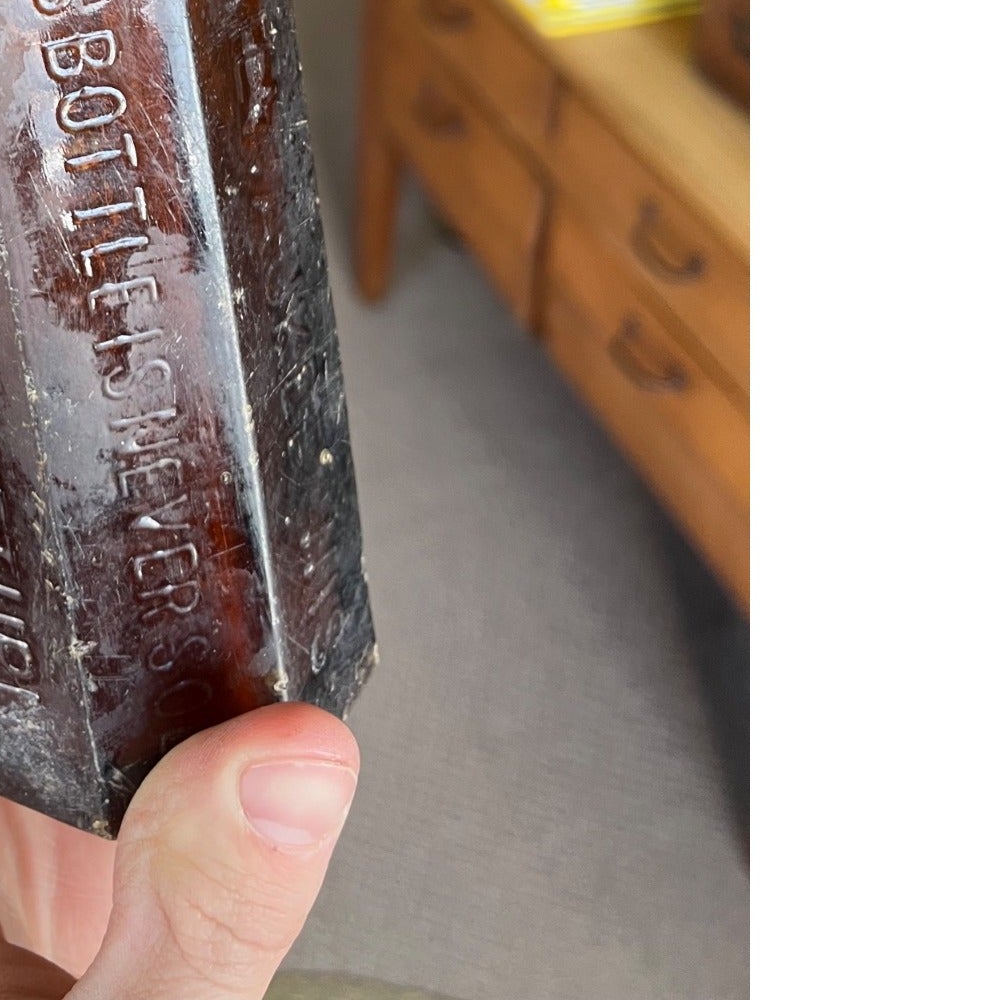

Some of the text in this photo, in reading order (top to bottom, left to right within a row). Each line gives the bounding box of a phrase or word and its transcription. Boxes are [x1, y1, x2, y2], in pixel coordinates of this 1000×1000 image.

[41, 29, 161, 315] BOTTLE
[94, 328, 175, 399] IS
[110, 408, 201, 618] NEVER
